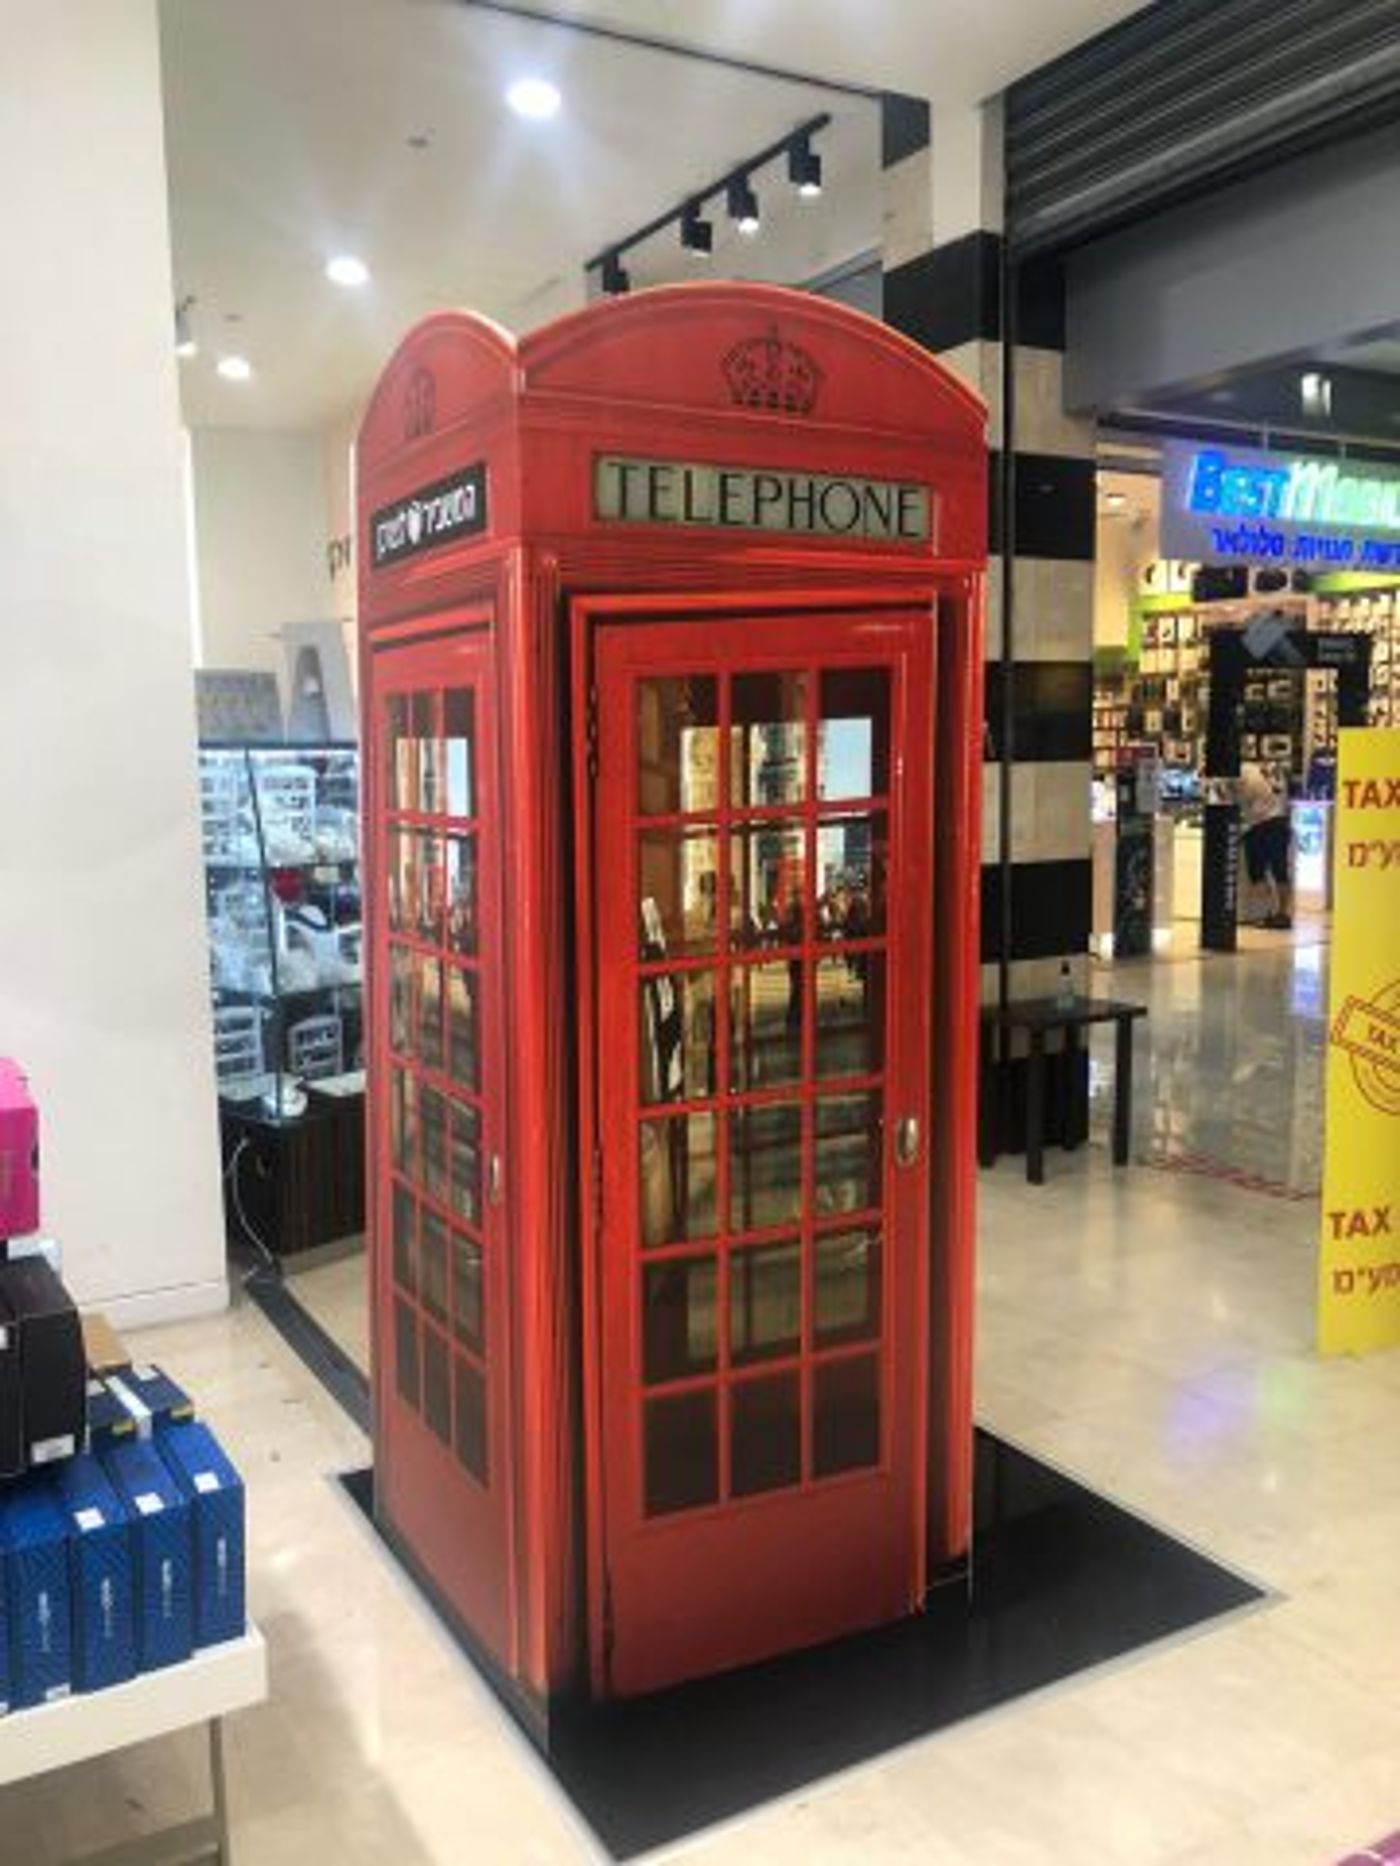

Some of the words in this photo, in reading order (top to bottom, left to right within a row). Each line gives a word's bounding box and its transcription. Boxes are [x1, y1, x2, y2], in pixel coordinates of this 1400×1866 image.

[607, 461, 920, 538] TELEPHONE
[1341, 778, 1400, 809] TAX
[1328, 1206, 1390, 1240] TAX
